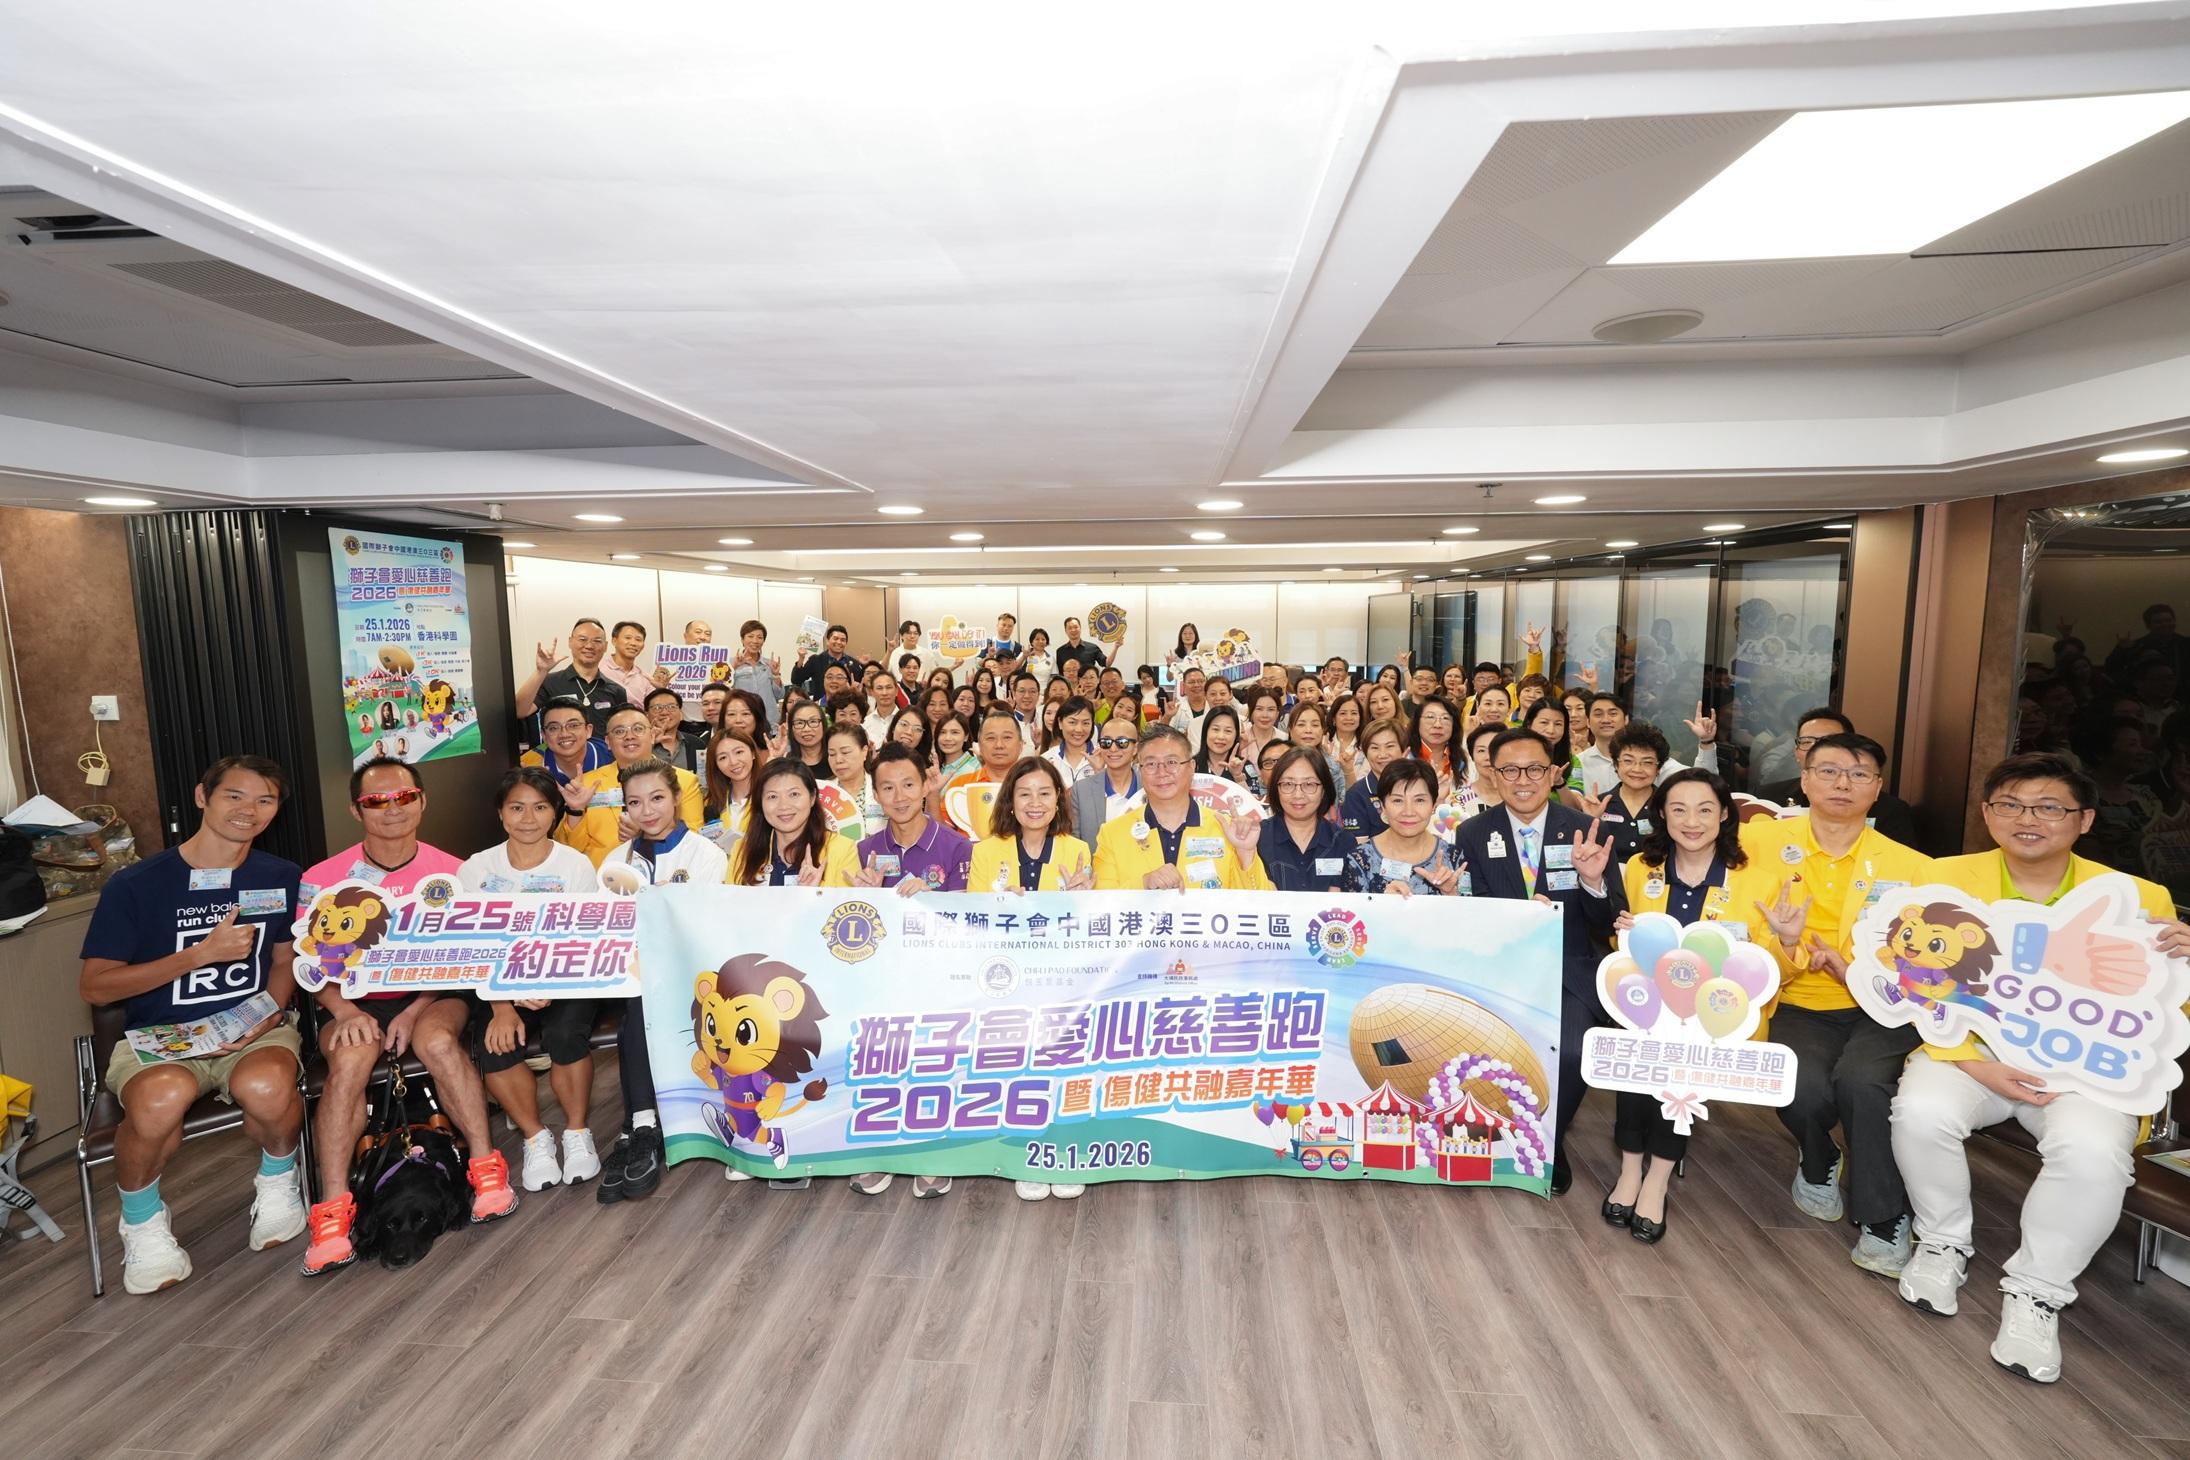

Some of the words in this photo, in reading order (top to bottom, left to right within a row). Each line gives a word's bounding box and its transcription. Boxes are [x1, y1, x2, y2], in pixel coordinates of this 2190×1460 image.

[349, 567, 452, 584] 獅子會愛心慈善跑
[351, 586, 397, 600] 2026
[365, 618, 411, 631] 25.1.2026
[1099, 615, 1116, 630] L
[366, 632, 412, 642] 7AM-2:30PM
[417, 631, 458, 641] 香港科學園
[657, 644, 697, 662] Lions
[701, 645, 728, 662] Run
[677, 664, 708, 679] 2026
[687, 691, 695, 699] be
[176, 906, 208, 917] new
[541, 900, 637, 932] 科學園
[836, 903, 874, 917] LIONS
[177, 917, 202, 928] run
[205, 912, 230, 924] clu
[847, 920, 863, 942] L
[902, 939, 935, 948] LIONS
[938, 940, 973, 949] CLUBS
[975, 940, 1060, 949] INTERNATIONAL
[1063, 940, 1111, 949] DISTRICT
[1137, 940, 1166, 948] HONG
[1170, 940, 1199, 949] KONG
[1202, 940, 1210, 949] &
[1213, 940, 1254, 951] MACAO,
[1257, 941, 1291, 951] CHINA
[502, 938, 633, 981] 約定你
[1993, 974, 2144, 1039] GOOD
[852, 988, 1326, 1077] 獅子會愛心慈善跑
[2000, 1011, 2130, 1080] JOB
[1593, 1035, 1786, 1074] 獅子會愛心慈善跑
[1594, 1060, 1669, 1083] 2026
[1061, 1079, 1093, 1112] 暨
[1103, 1064, 1317, 1108] 傷健共融嘉年華
[854, 1079, 1051, 1132] 2026
[1026, 1141, 1151, 1170] 25.1.2026
